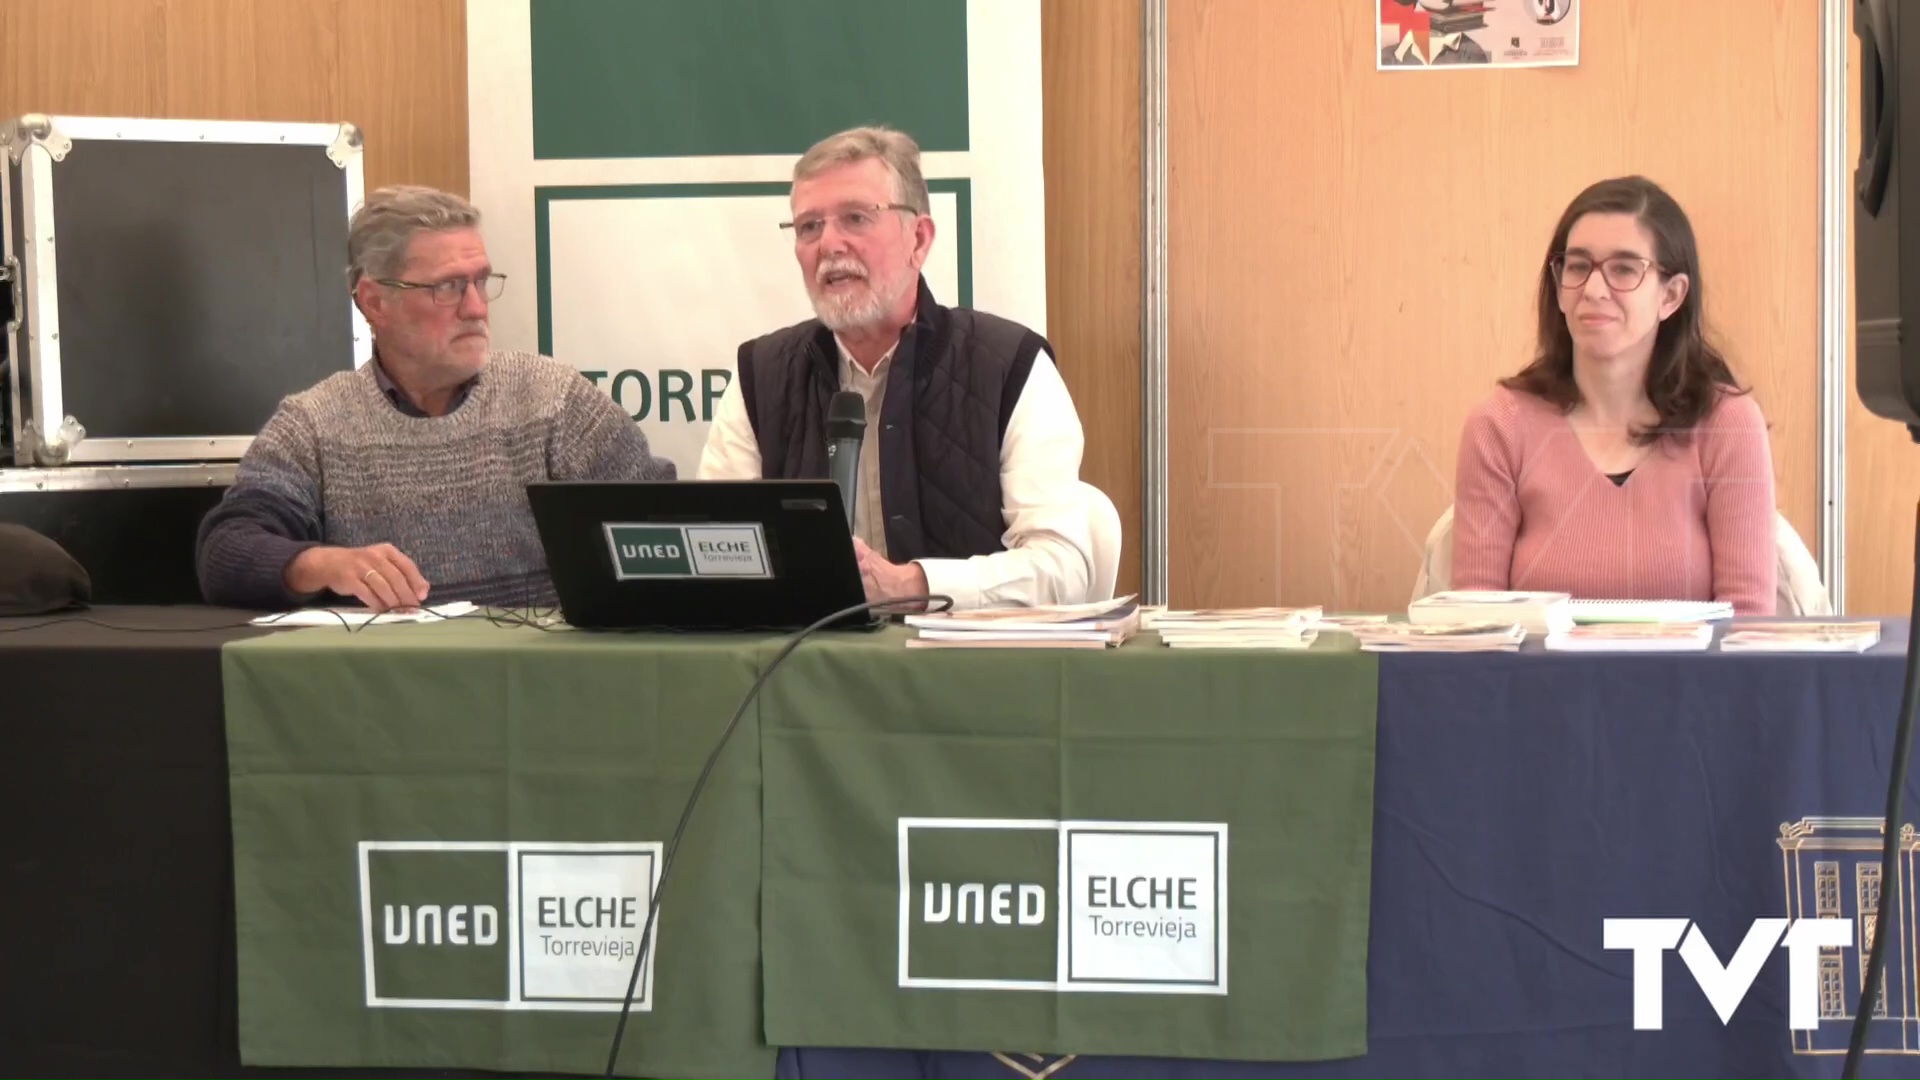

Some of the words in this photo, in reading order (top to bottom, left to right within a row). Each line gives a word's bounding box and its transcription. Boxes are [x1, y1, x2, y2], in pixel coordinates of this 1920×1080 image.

[622, 543, 681, 559] UNED
[698, 540, 750, 553] ELCHE
[924, 882, 1045, 926] UNED
[1088, 875, 1198, 910] ELCHE
[384, 904, 499, 946] UNED
[537, 896, 637, 929] ELCHE
[1088, 914, 1197, 943] Torrevieja
[539, 935, 635, 962] Torrevieja
